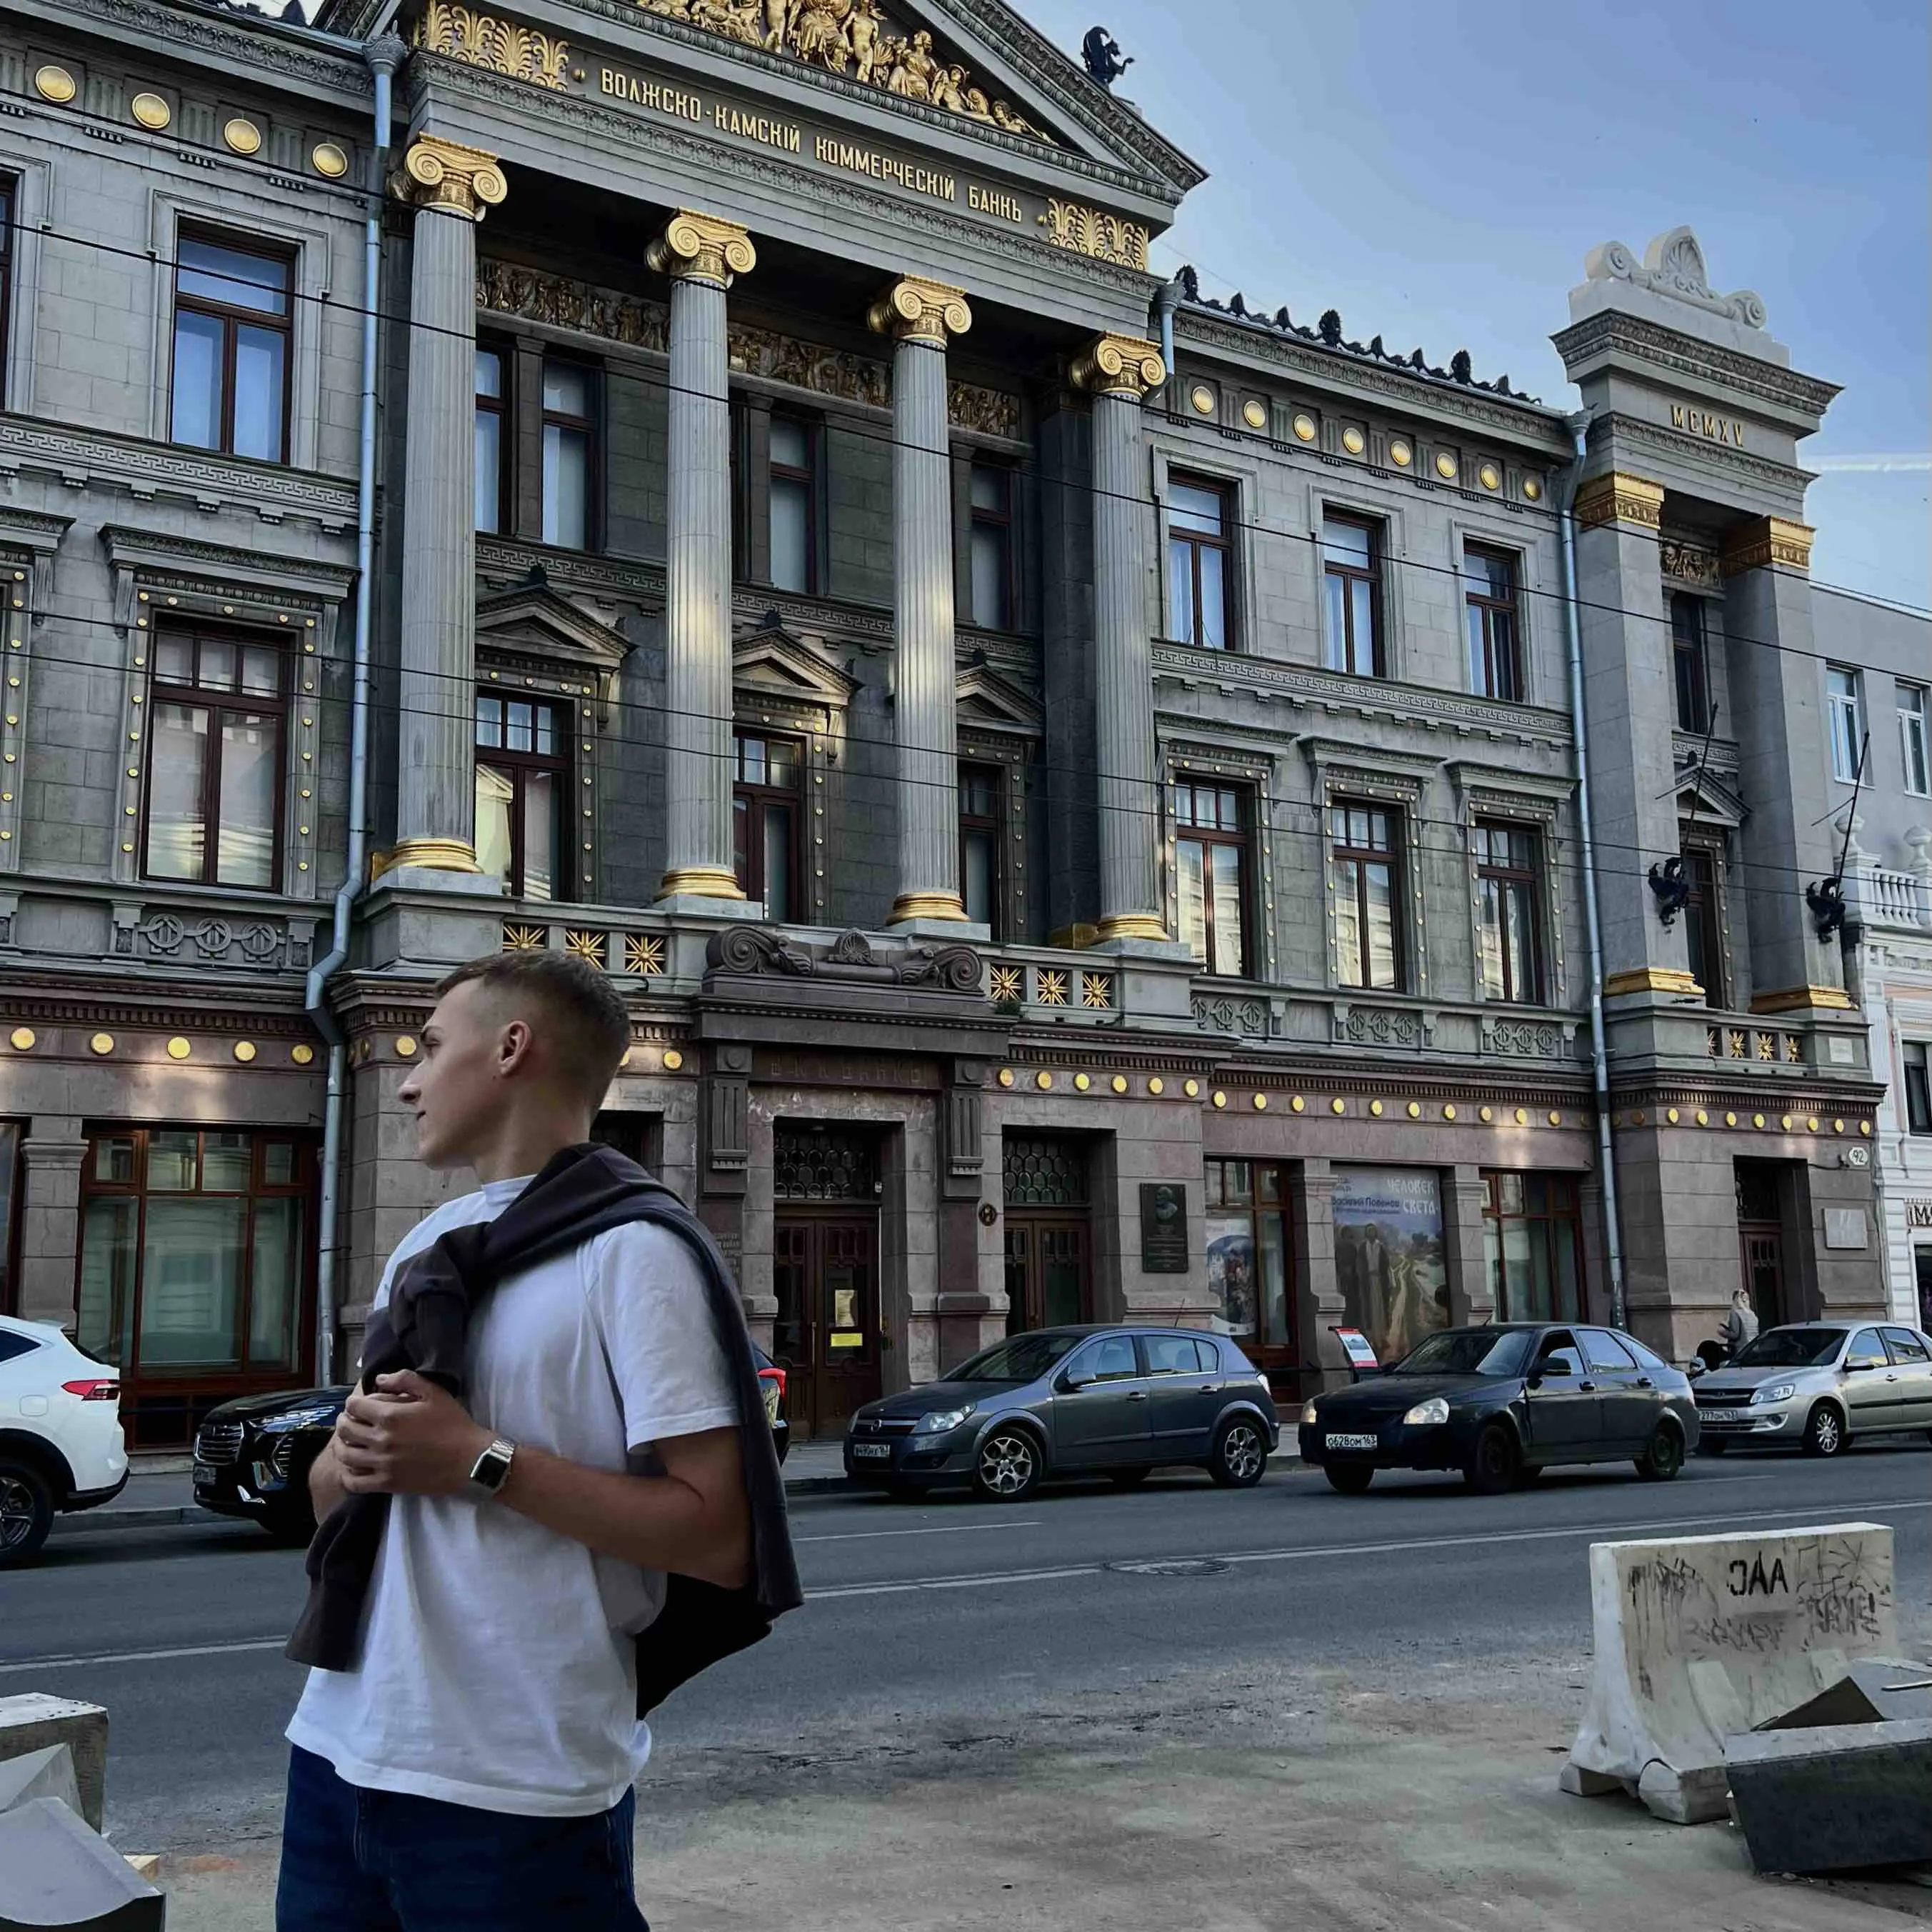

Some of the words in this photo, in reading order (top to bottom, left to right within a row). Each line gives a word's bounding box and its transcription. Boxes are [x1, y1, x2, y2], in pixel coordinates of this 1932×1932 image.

[815, 136, 955, 202] КОММЕРЧЕСКІЙ
[968, 185, 1021, 223] БАНКЪ
[1671, 405, 1743, 447] MCMXV
[1853, 1150, 1863, 1163] 92
[1384, 1178, 1434, 1195] ЧЕЛОВЕК
